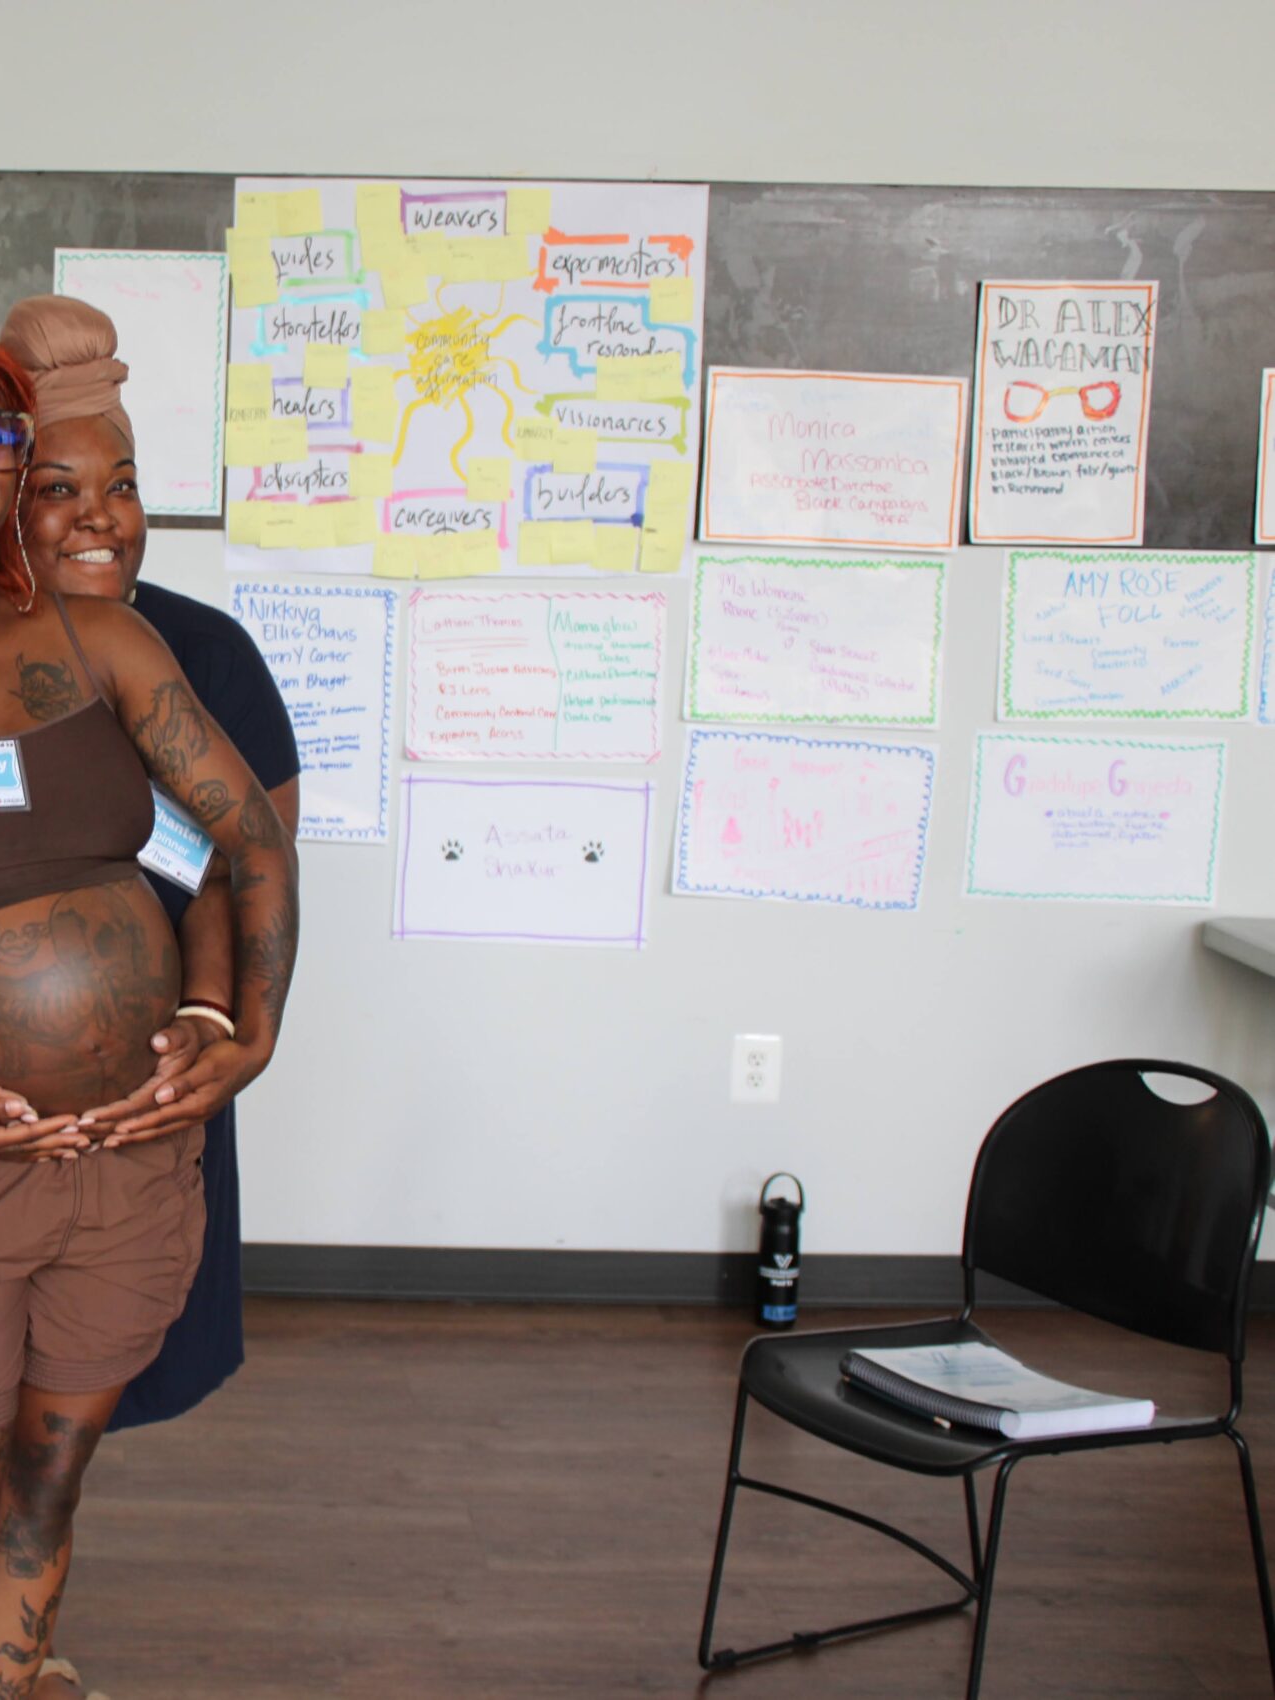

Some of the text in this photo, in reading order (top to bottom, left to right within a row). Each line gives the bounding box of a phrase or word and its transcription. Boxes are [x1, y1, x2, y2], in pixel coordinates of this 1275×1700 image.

[413, 203, 499, 230] weavers
[554, 303, 642, 356] frontline
[1054, 299, 1154, 338] ALEX
[272, 387, 337, 423] healers
[767, 412, 857, 440] Monica
[536, 475, 632, 511] builders
[1007, 482, 1066, 497] Richmond
[1062, 568, 1181, 599] AMY ROSE
[248, 597, 321, 624] Nikkiya
[1097, 603, 1163, 628] FOLL
[263, 623, 302, 642] Ellis
[309, 648, 352, 665] Carter
[152, 829, 189, 856] pinner
[483, 824, 572, 844] Assata
